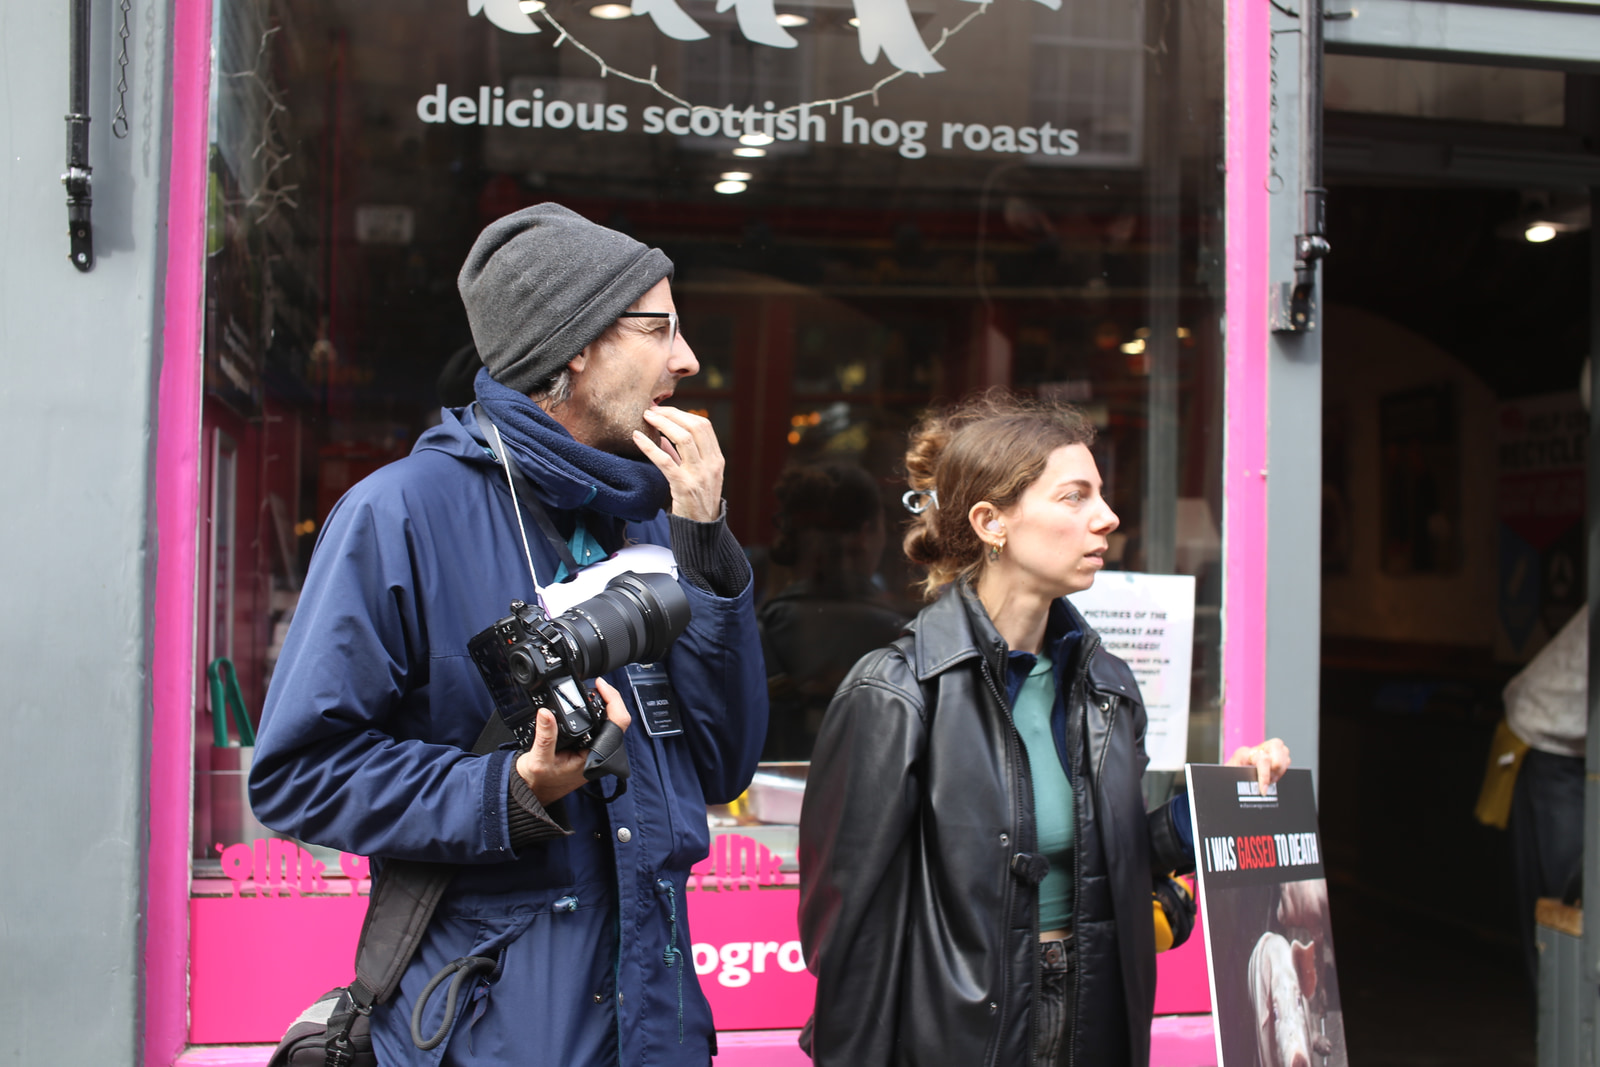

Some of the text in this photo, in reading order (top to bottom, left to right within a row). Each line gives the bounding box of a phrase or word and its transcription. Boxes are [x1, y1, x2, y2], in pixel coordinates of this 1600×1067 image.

[416, 83, 1080, 159] delicious scottish hog roasts
[1084, 611, 1131, 619] PICTURES
[1103, 642, 1160, 651] COURAGED!
[1204, 832, 1319, 873] I WAS GASSED TO DEATH
